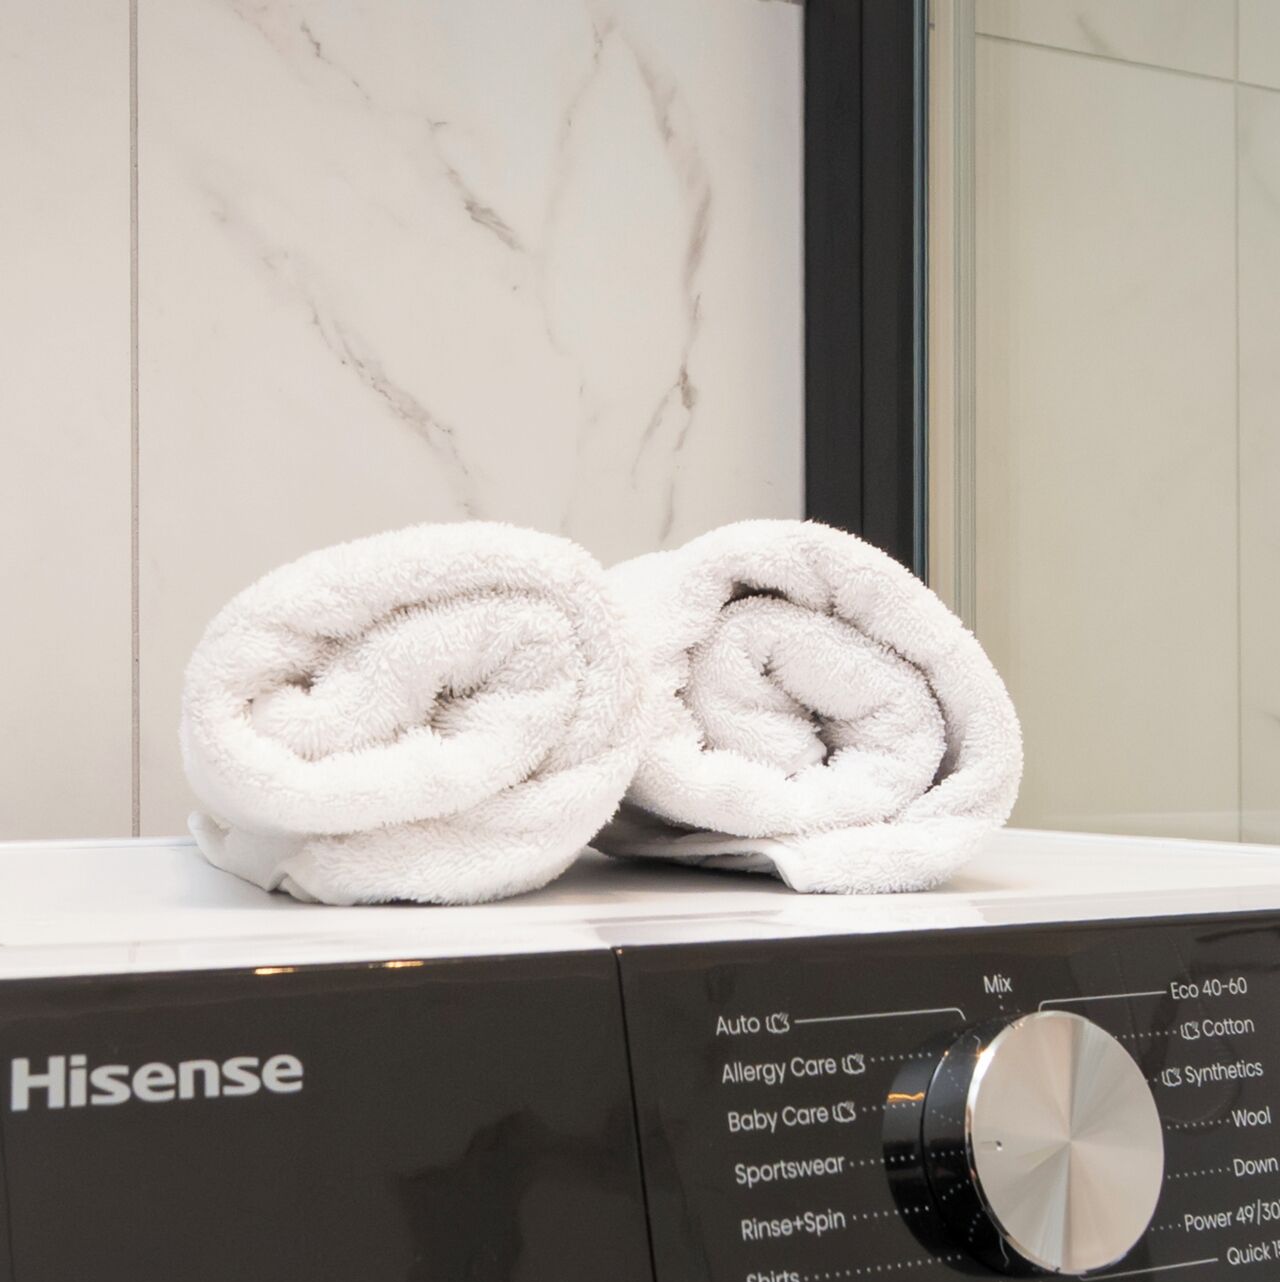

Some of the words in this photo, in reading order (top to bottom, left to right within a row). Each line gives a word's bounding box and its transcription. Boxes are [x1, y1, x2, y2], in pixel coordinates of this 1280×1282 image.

[984, 975, 1012, 994] Mix
[1170, 982, 1199, 1000] Eco
[1202, 976, 1248, 997] 40-60
[716, 1014, 760, 1035] Auto
[1202, 1018, 1255, 1037] Cotton
[10, 1052, 305, 1112] Hisense
[721, 1058, 785, 1085] Allergy
[789, 1055, 836, 1078] Care
[1185, 1060, 1264, 1088] Synthetics
[728, 1108, 777, 1136] Baby
[782, 1104, 829, 1127] Care
[1232, 1106, 1272, 1127] Wool
[734, 1155, 845, 1188] Sportswear
[1233, 1157, 1280, 1177] Down
[742, 1209, 846, 1241] Rinse+Spin
[1184, 1211, 1233, 1232] Power
[1227, 1242, 1271, 1266] Quick
